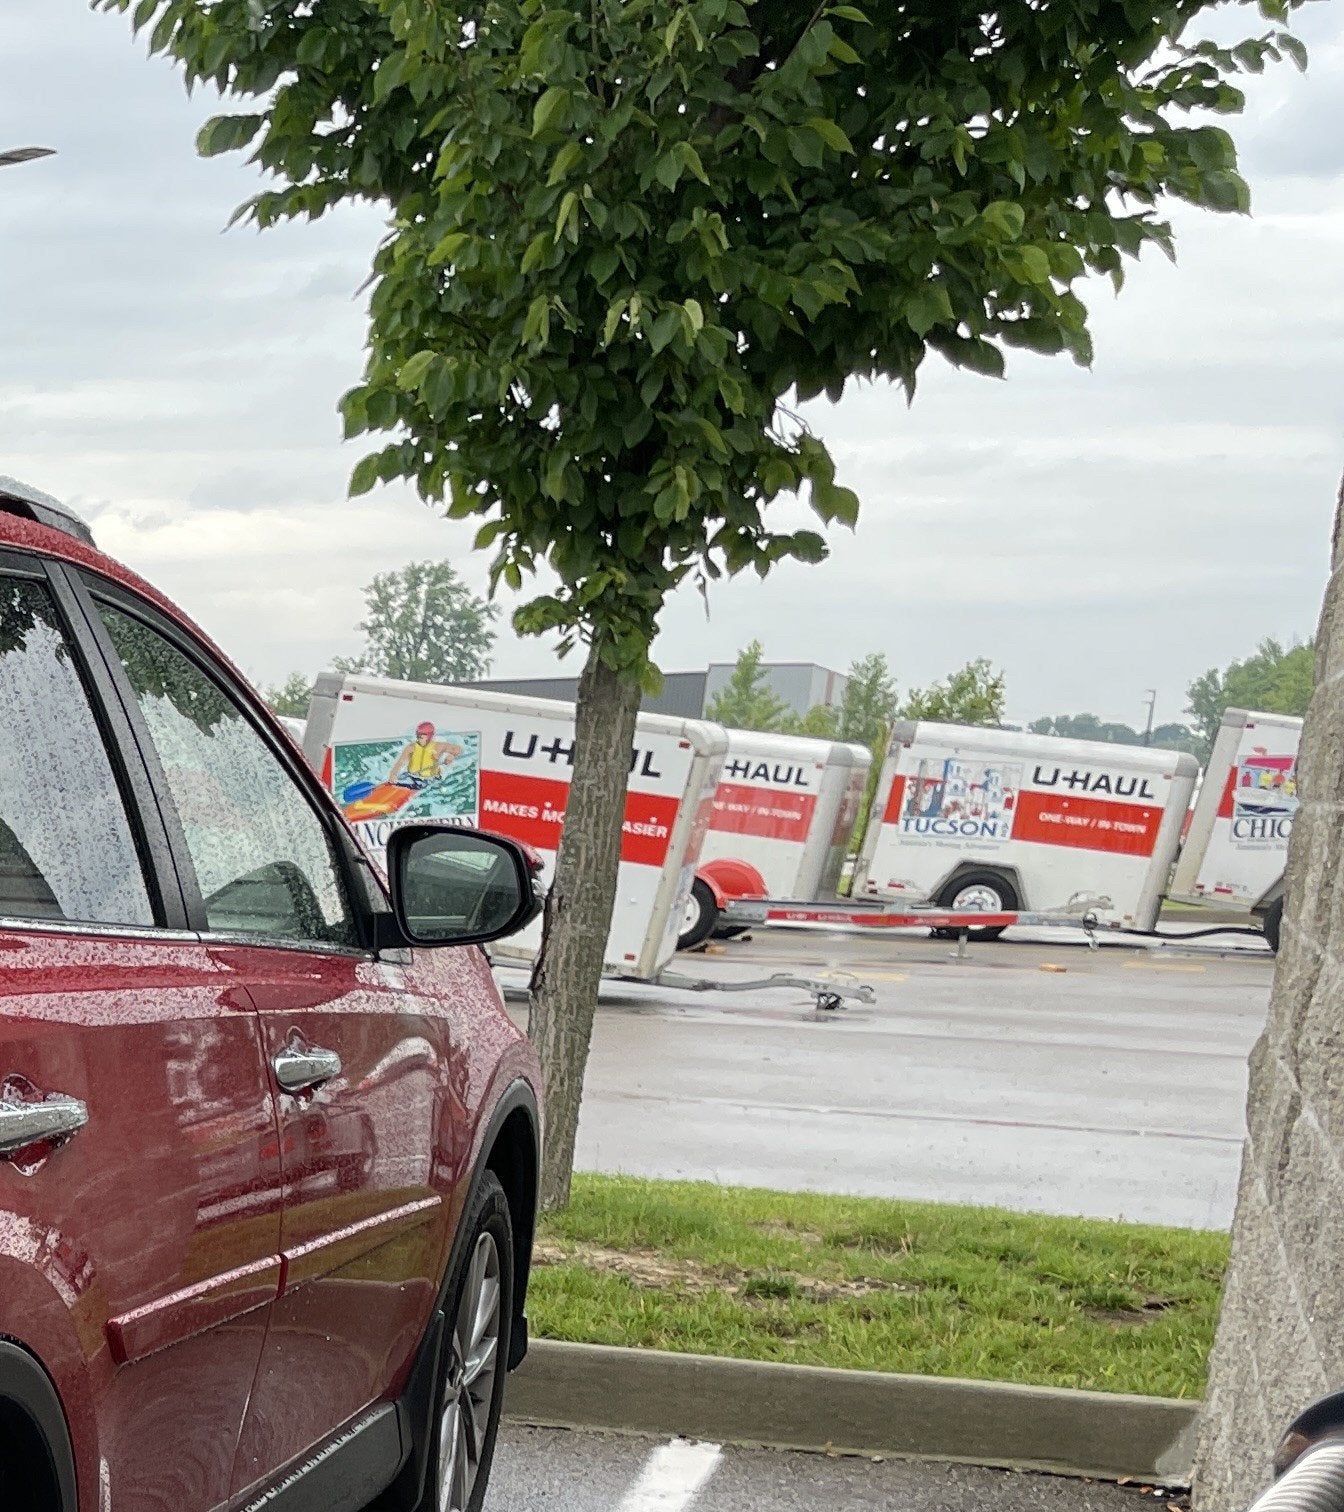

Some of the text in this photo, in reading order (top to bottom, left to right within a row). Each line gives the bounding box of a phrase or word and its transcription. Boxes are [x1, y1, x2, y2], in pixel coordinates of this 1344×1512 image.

[502, 731, 661, 778] U-HL
[725, 759, 810, 786] -HAUL
[1032, 765, 1155, 799] U-HAUL
[483, 799, 539, 820] MAKES
[622, 820, 669, 838] ASIER
[901, 815, 998, 837] TUCSON
[1233, 818, 1292, 839] CHIC
